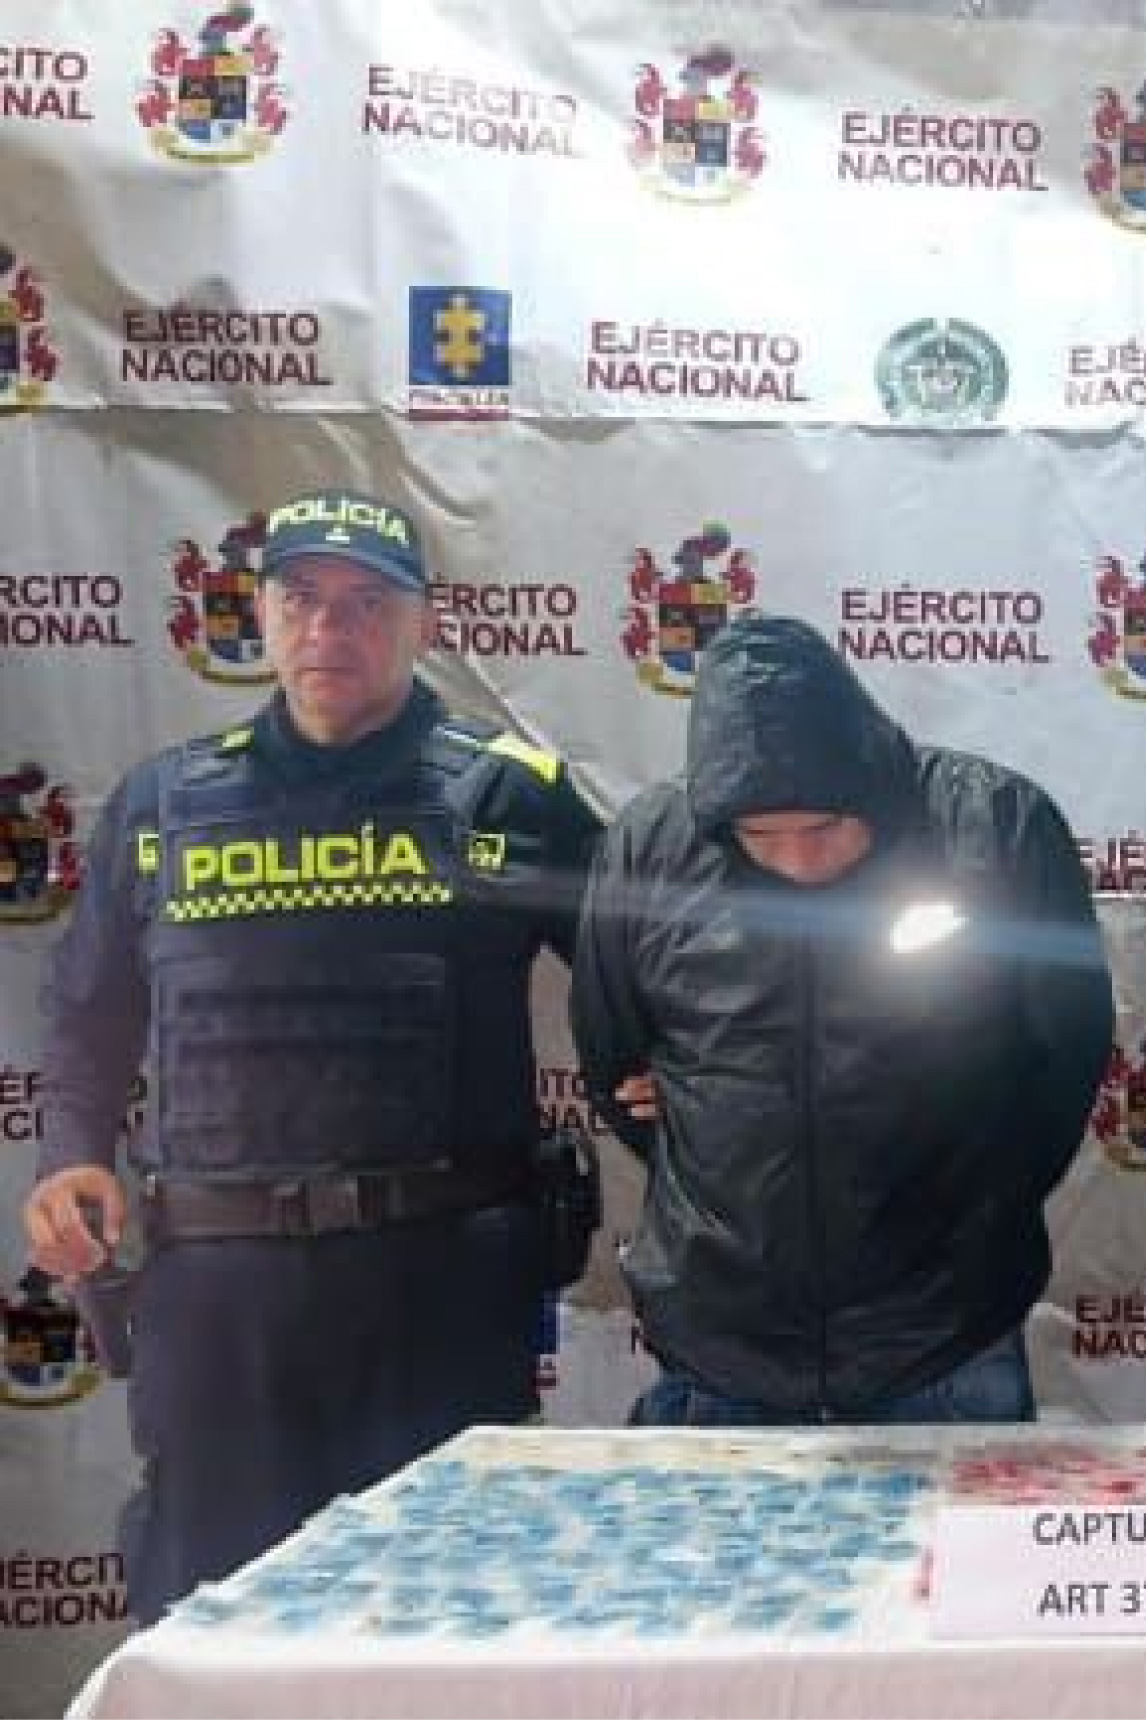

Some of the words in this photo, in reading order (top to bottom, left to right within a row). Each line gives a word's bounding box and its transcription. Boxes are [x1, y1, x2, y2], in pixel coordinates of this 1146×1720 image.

[362, 102, 588, 158] NACIONAL
[842, 103, 1041, 151] EJÉRCITO
[838, 151, 1049, 191] NACIONAL
[591, 318, 802, 366] EJÉRCITO
[120, 350, 333, 385] NACIONAL
[587, 357, 811, 402] NACIONAL
[842, 582, 1044, 625] EJÉRCITO
[838, 627, 1049, 664] NACIONAL
[184, 820, 427, 890] POLICÍA
[1037, 1581, 1111, 1616] ART
